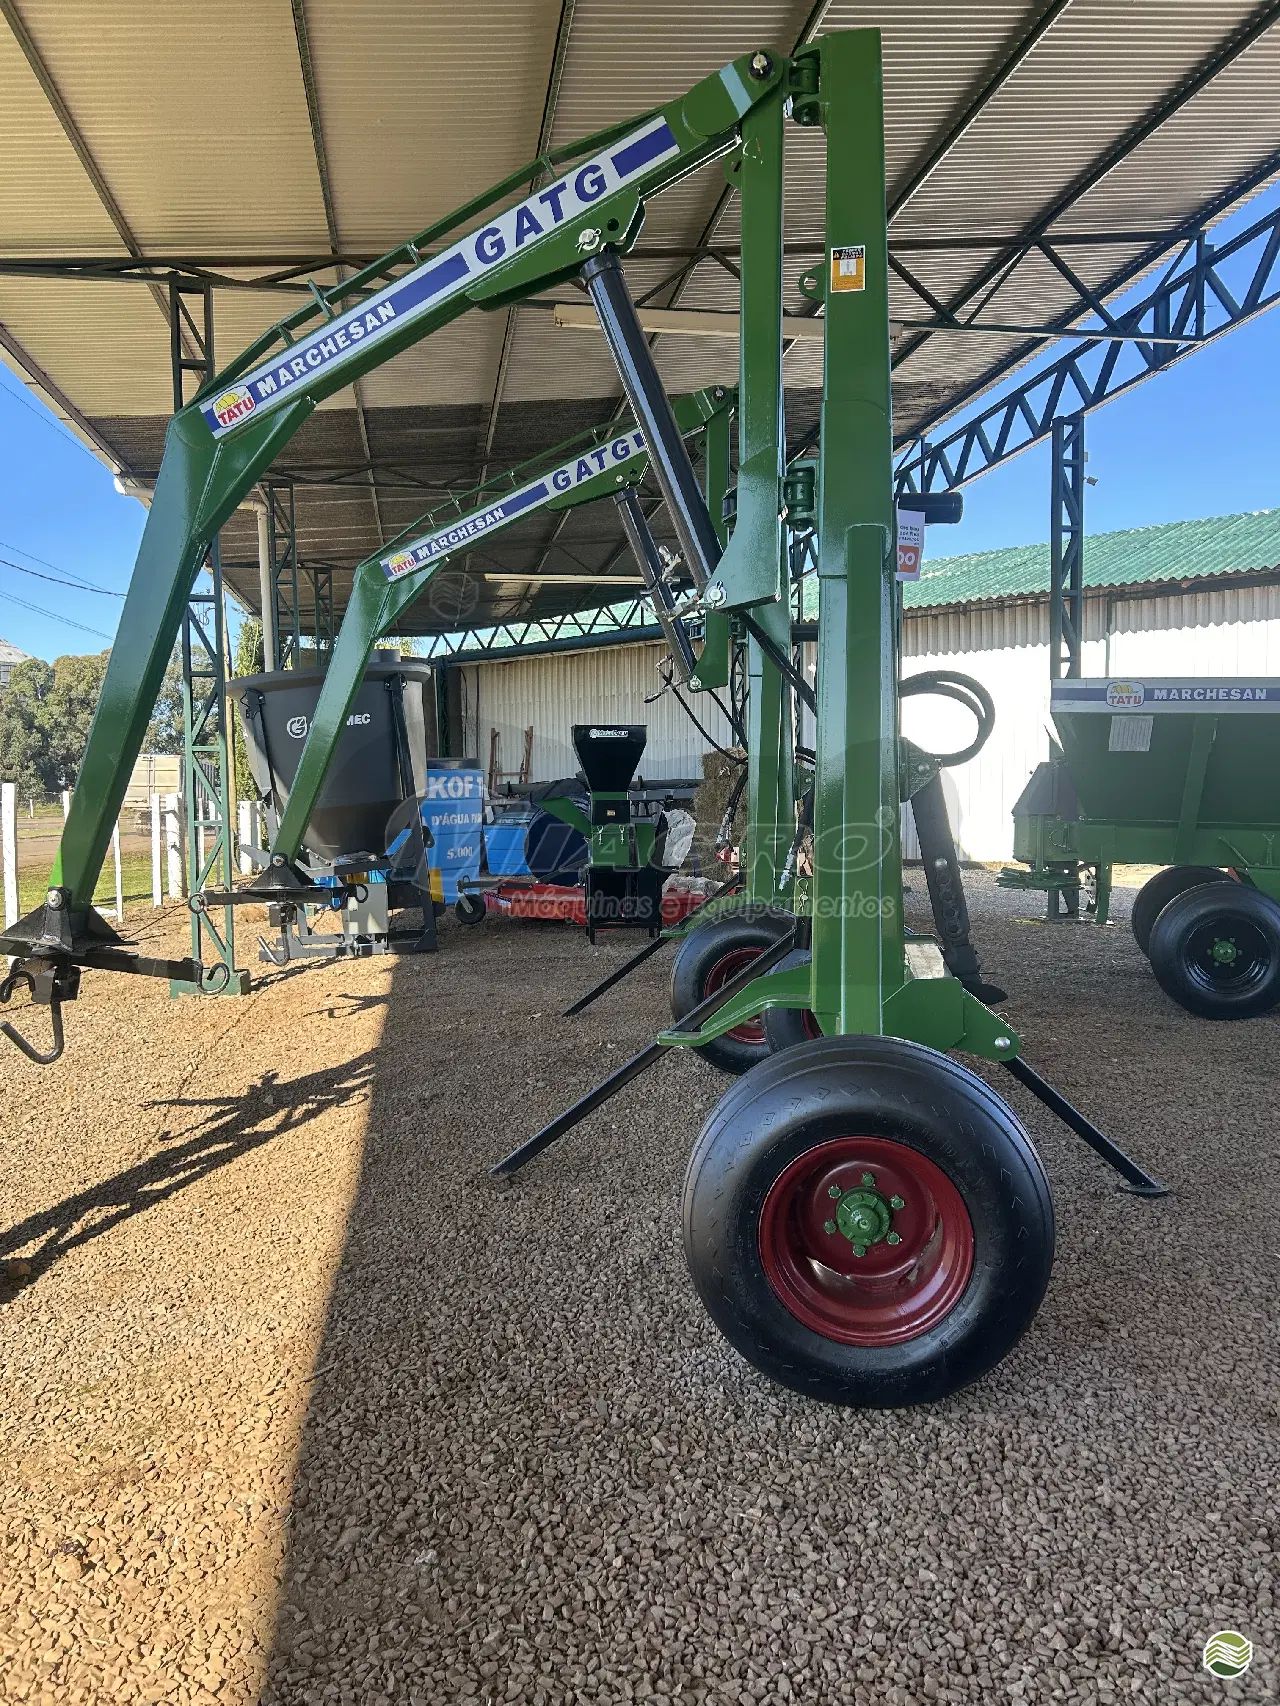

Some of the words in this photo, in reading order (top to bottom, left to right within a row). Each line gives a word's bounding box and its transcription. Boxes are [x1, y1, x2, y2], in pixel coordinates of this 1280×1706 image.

[218, 396, 255, 425] TATU
[256, 300, 396, 398] MARCHESAN
[474, 164, 608, 264] GATG
[392, 558, 416, 574] TATU
[416, 507, 505, 560] MARCHESAN
[552, 438, 631, 491] GATG
[1108, 695, 1142, 705] TATU
[1153, 688, 1268, 700] MARCHESAN
[431, 812, 470, 827] D'ÁGUA
